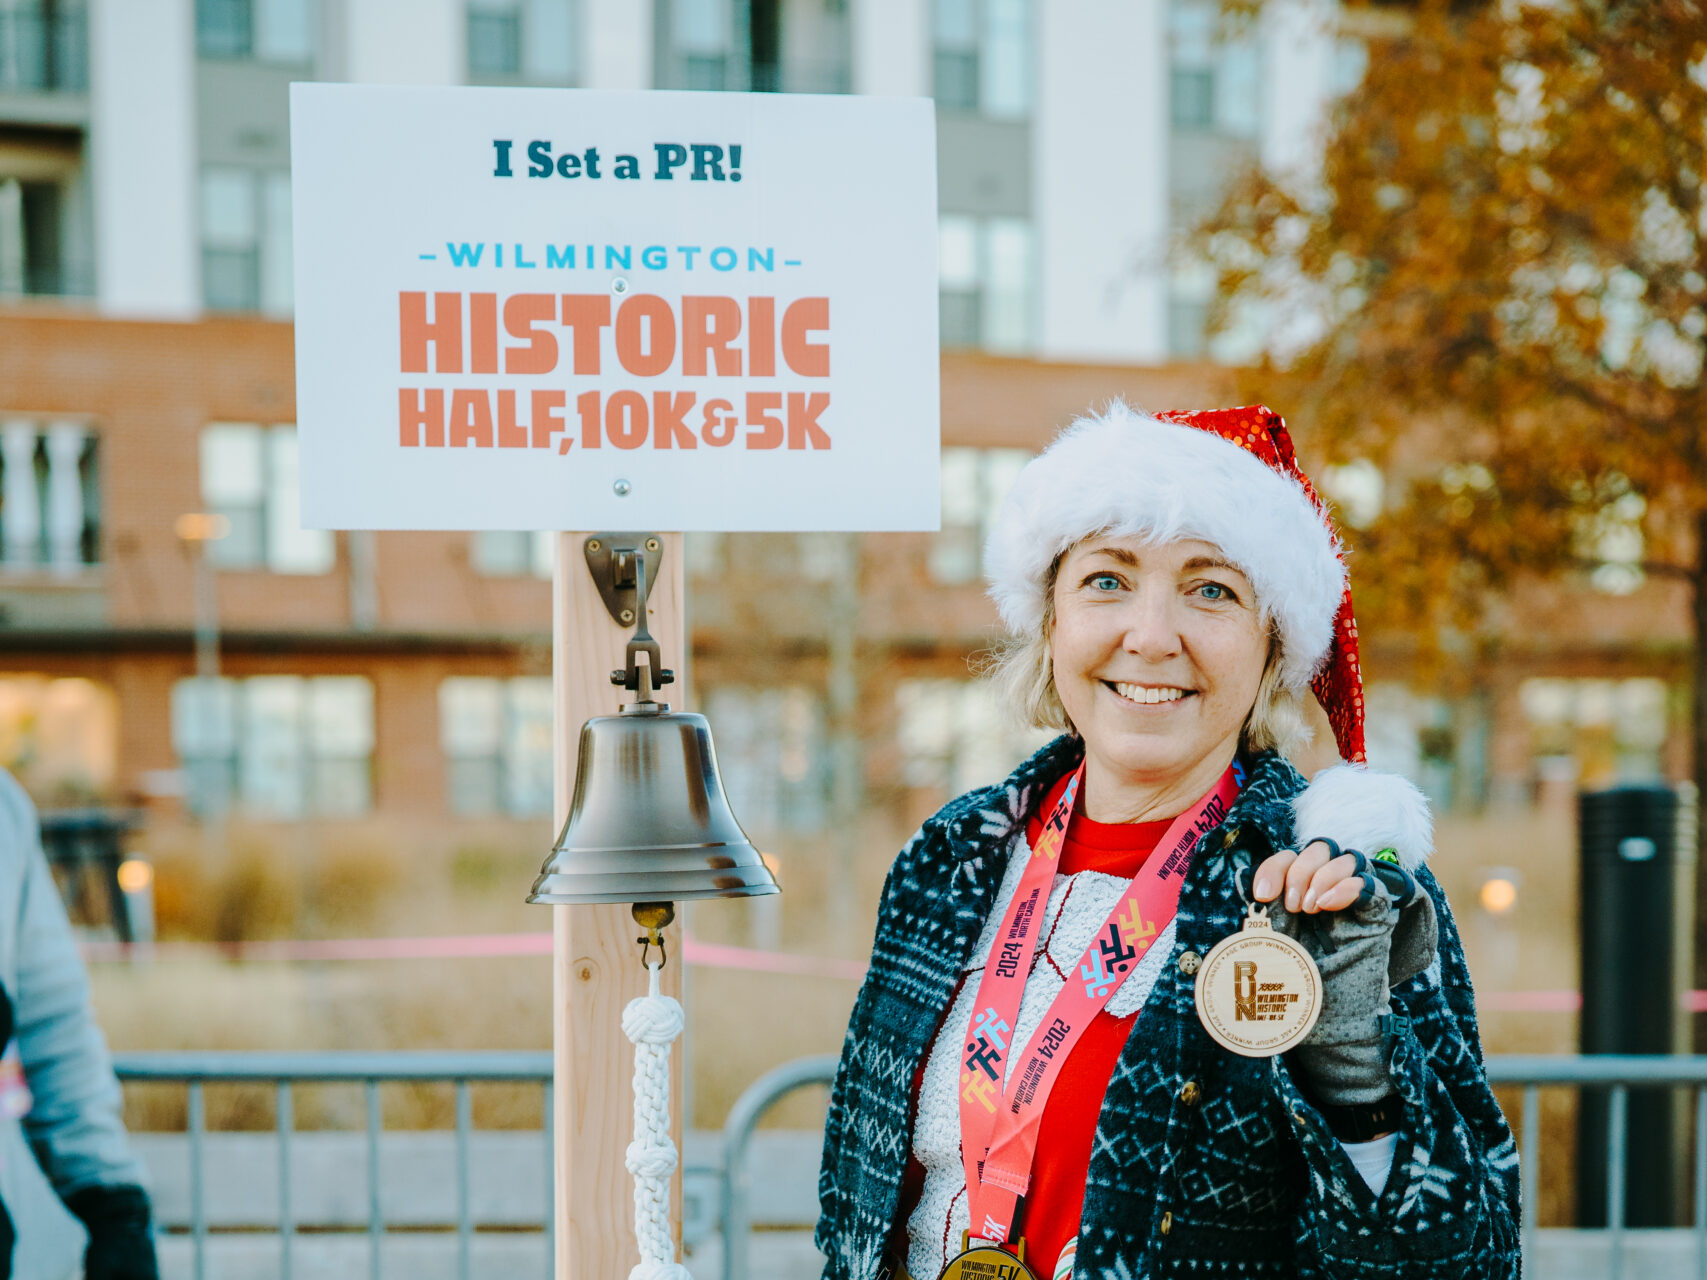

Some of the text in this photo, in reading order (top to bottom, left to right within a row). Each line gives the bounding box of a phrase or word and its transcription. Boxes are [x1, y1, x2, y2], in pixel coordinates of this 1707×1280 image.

[493, 140, 742, 182] I Set a PR!
[399, 291, 830, 377] HISTORIC
[1194, 794, 1229, 833] 2024
[1157, 828, 1198, 880] NORTH CAROLINA
[1018, 888, 1040, 938] NORTH CAROLINA
[1248, 921, 1269, 929] 2024
[996, 942, 1023, 978] 2024
[1234, 961, 1257, 1021] RUN
[1257, 993, 1299, 1003] WILMINGTON
[1257, 1003, 1287, 1013] HISTORIC
[1037, 1018, 1071, 1060] 2024
[1011, 1056, 1039, 1114] NORTH CAROLINA
[982, 1213, 1007, 1243] 5K
[961, 1260, 997, 1274] WILMINGTON
